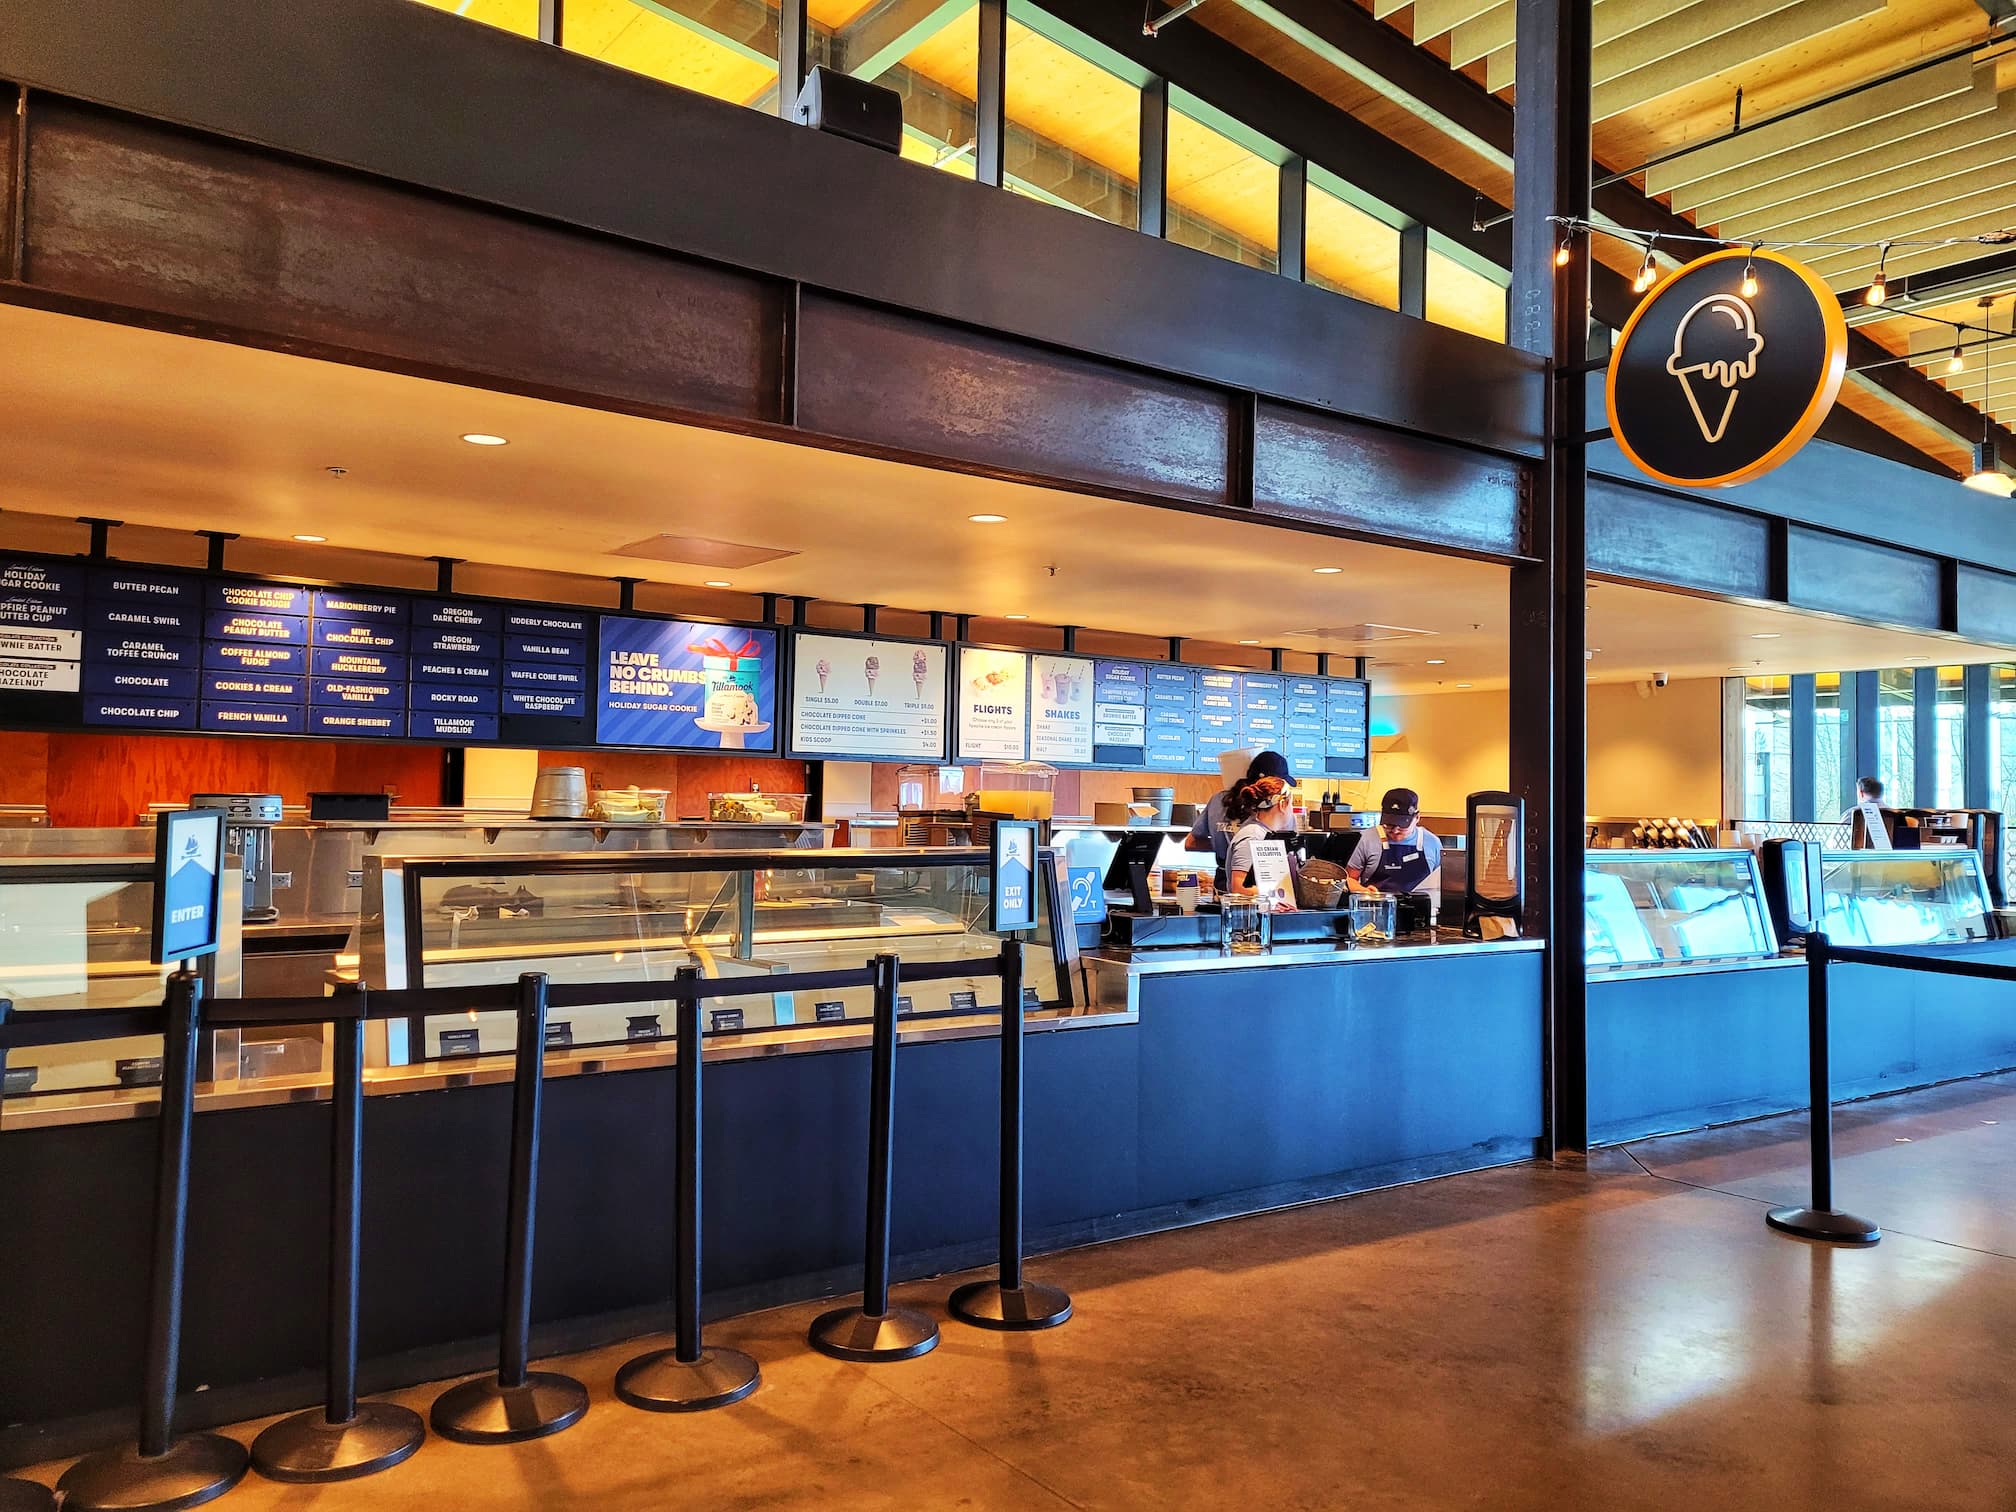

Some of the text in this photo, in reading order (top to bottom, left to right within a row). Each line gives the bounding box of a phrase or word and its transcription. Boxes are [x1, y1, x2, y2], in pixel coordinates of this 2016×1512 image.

[4, 570, 46, 581] HOLIDAY
[0, 578, 61, 591] GAR COOKIE
[113, 581, 179, 595] BUTTER PECAN
[222, 587, 295, 601] CHOCOLATE CHIP
[225, 596, 291, 609] COOKIE DOUGH
[326, 600, 396, 614] MARIONBERRY PIE
[30, 604, 68, 615] PEANUT
[442, 607, 474, 617] OREGON
[32, 613, 53, 622] CUP
[108, 612, 181, 626] CARAMEL SWIRL
[432, 614, 483, 625] DARK CHERRY
[232, 618, 282, 629] CHOCOLATE
[511, 617, 583, 630] UDDERLY CHOCOLATE
[223, 626, 290, 638] PEANUT BUTTER
[351, 627, 371, 636] MINT
[326, 633, 394, 646] CHOCOLATE CHIP
[441, 635, 473, 644] OREGON
[28, 642, 62, 651] BATTER
[122, 640, 165, 651] CARAMEL
[433, 641, 481, 652] STRAWBERRY
[522, 644, 570, 655] VANILLA BEAN
[107, 648, 179, 660] TOFFEE CRUNCH
[220, 647, 291, 660] COFFEE ALMOND
[610, 650, 659, 667] LEAVE
[241, 657, 270, 667] FUDGE
[338, 656, 381, 665] MOUNTAIN
[331, 663, 387, 674] HUCKLEBERRY
[422, 665, 456, 675] PEACHES
[463, 668, 489, 677] CREAM
[511, 671, 578, 682] WAFFLE CONE SWIRL
[609, 665, 706, 685] NO CRUMBS
[0, 678, 44, 687] AZELNUT
[114, 676, 169, 687] CHOCOLATE
[711, 680, 753, 692] Tillamook
[215, 681, 293, 694] COOKIES & CREAM
[326, 684, 390, 695] OLD-FASHIONED
[609, 680, 673, 697] BEHIND.
[342, 692, 375, 702] VANILLA
[431, 693, 479, 703] ROCKY ROAD
[513, 694, 576, 705] WHITE CHOCOLATE
[100, 706, 180, 718] CHOCOLATE CHIP
[524, 702, 565, 712] RASPBERRY
[608, 701, 698, 713] HOLIDAY SUGAR COOKIE
[973, 704, 1013, 715] FLIGHTS
[218, 711, 288, 723] FRENCH VANILLA
[800, 711, 832, 719] CHOCOLATE
[1045, 709, 1080, 720] SHAKES
[323, 716, 391, 727] ORANGE SHERBET
[433, 718, 475, 727] TILLAMOOK
[800, 723, 831, 731] CHOCOLATE
[435, 725, 473, 734] MUDSLIDE
[1004, 886, 1022, 897] EXIT
[1003, 898, 1023, 909] ONLY
[171, 905, 205, 924] ENTER
